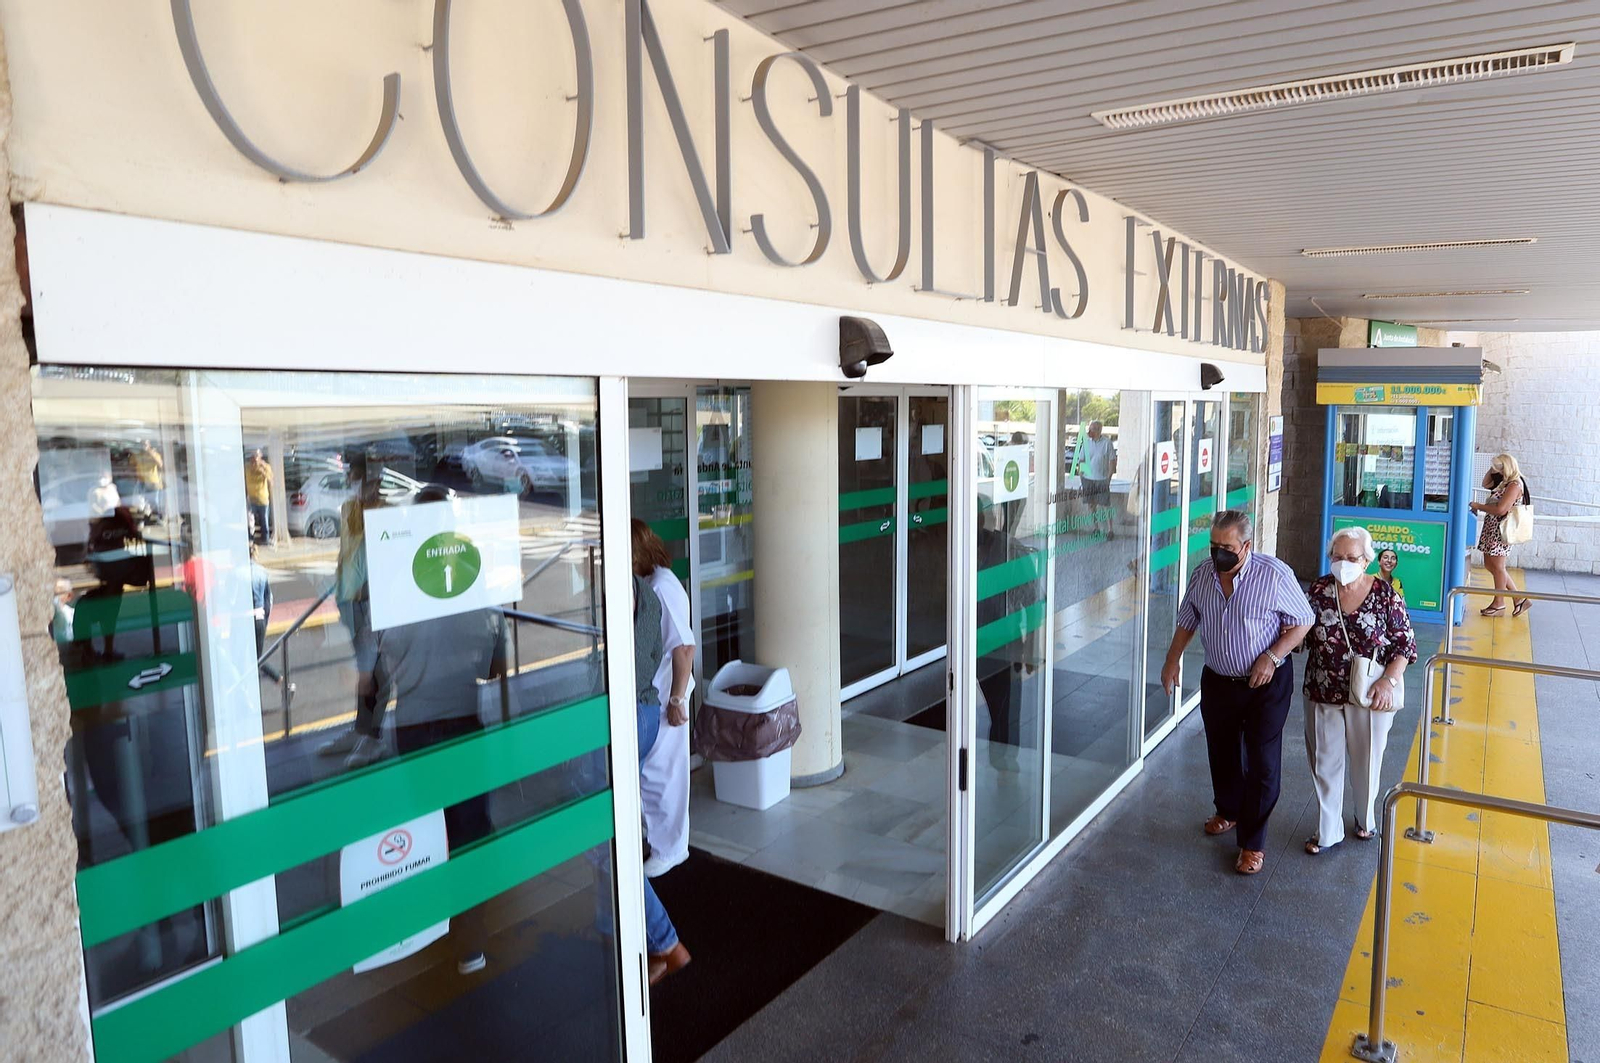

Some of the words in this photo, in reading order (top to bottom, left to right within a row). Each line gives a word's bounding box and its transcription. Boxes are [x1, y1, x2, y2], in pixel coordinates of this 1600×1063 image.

[170, 0, 1090, 320] CONSULTAS
[1124, 215, 1269, 354] EXTERNAS
[1366, 524, 1410, 535] CUANDO
[1371, 532, 1398, 542] EGAS
[426, 544, 467, 559] ENTRADA
[1396, 542, 1431, 555] TODOS
[360, 866, 403, 891] PROHIBIDO
[405, 856, 431, 872] FUMAR
